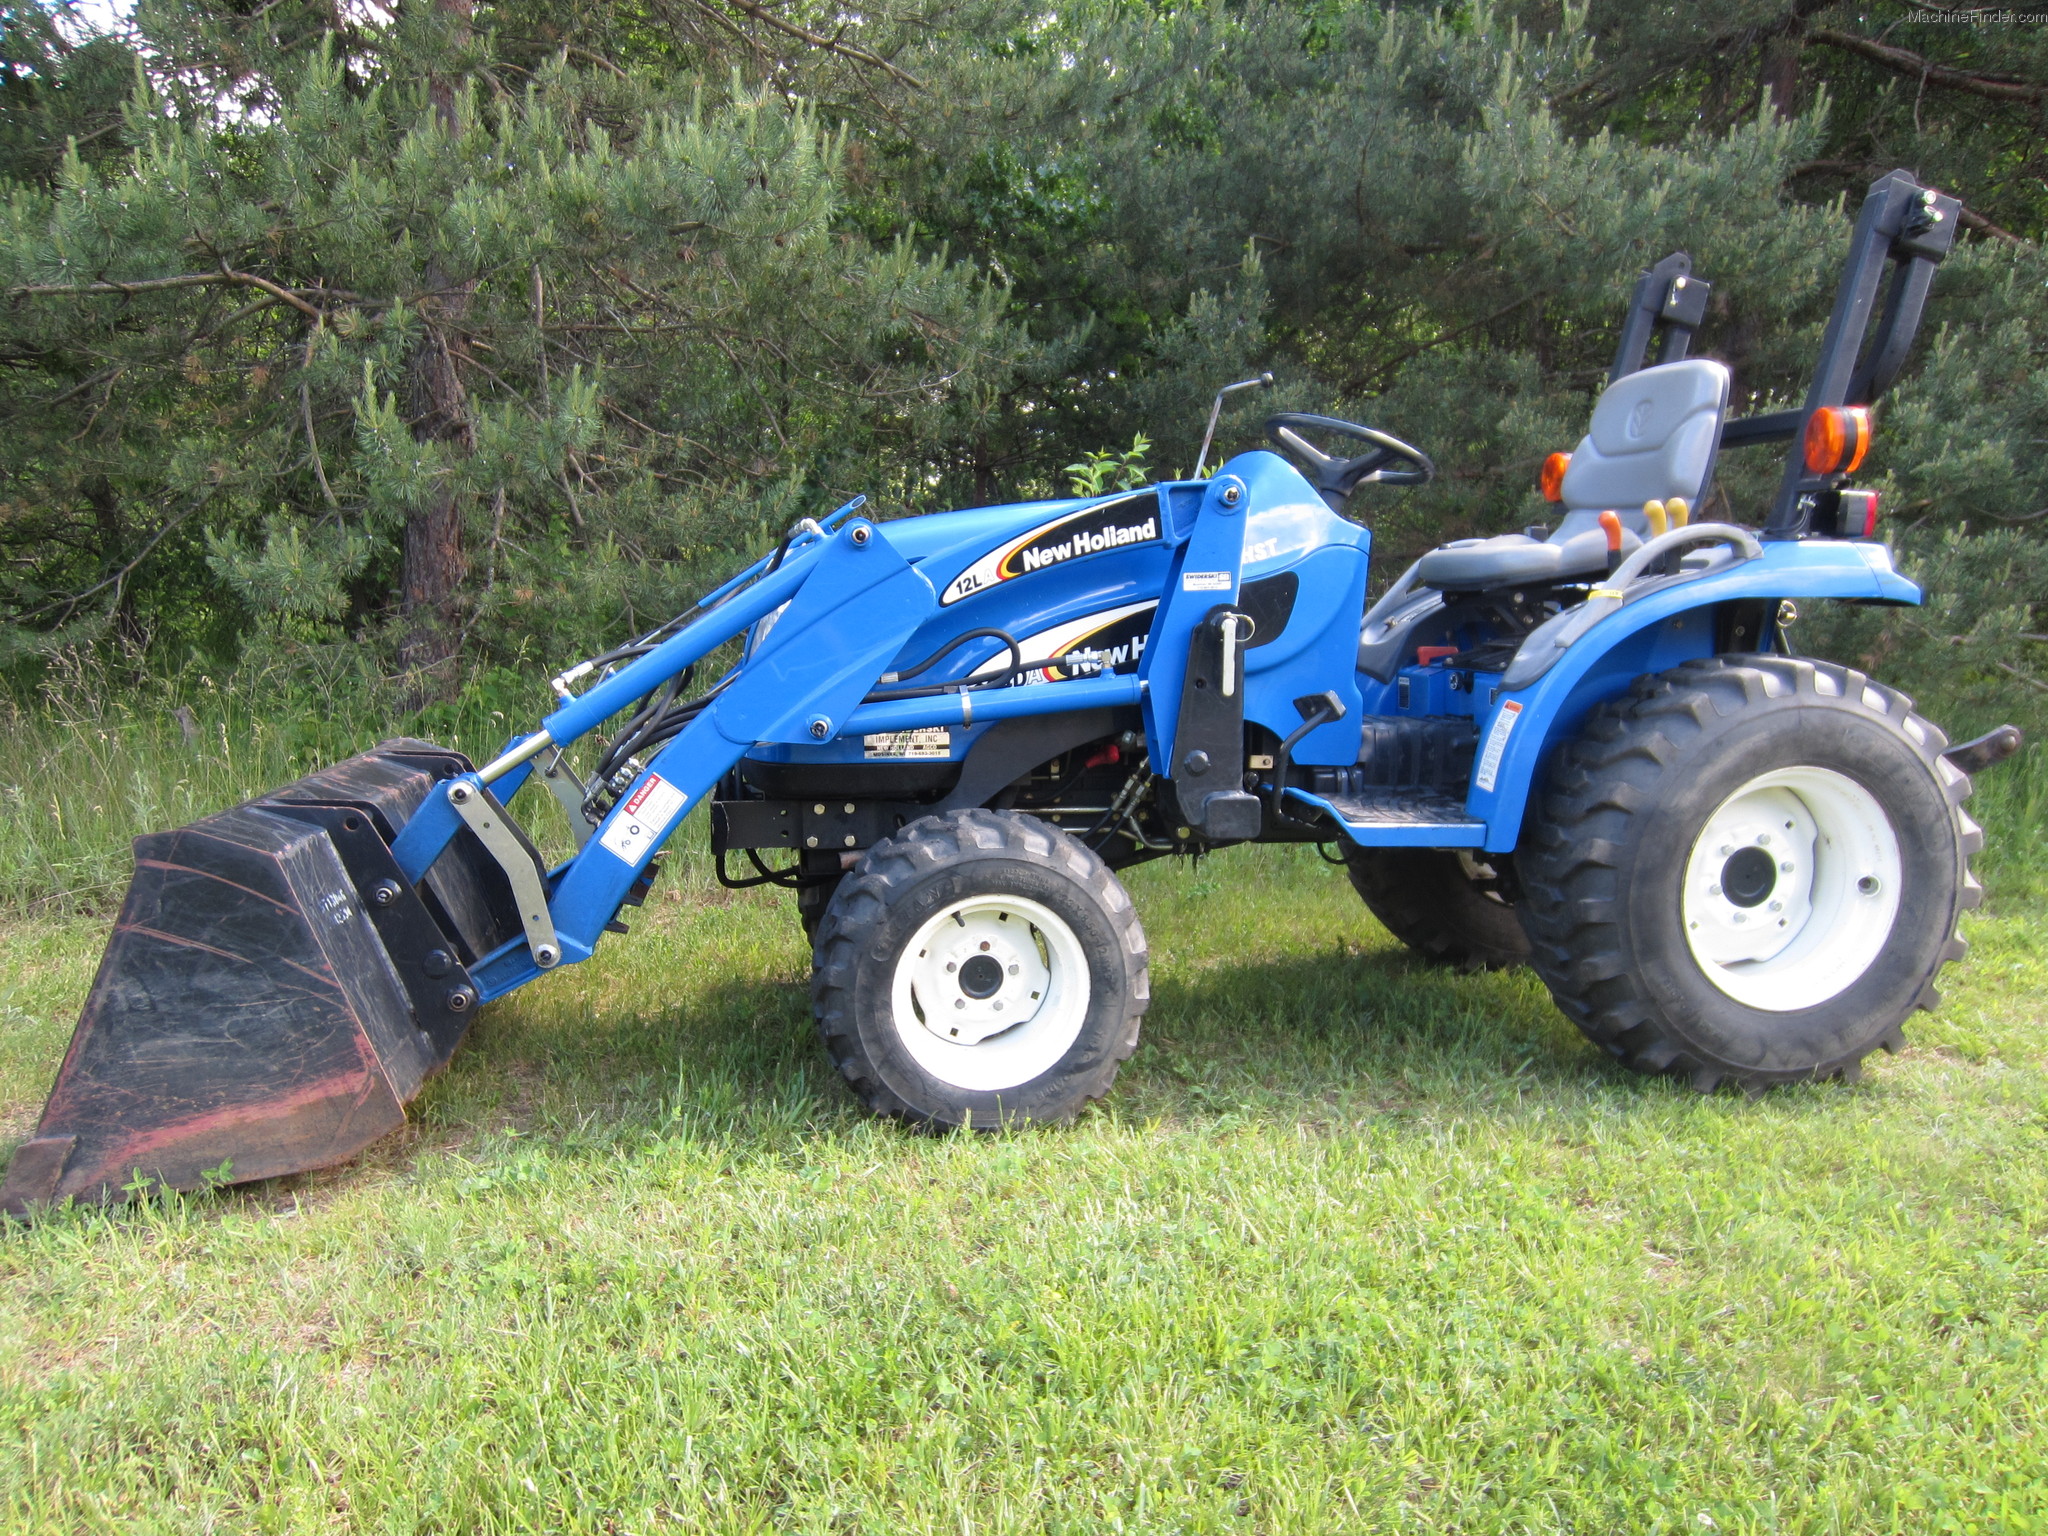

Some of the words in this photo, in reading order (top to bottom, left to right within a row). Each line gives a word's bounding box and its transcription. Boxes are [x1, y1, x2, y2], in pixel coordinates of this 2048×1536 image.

[1022, 540, 1072, 572] New
[1073, 517, 1156, 556] Holland
[633, 776, 658, 806] DANGER
